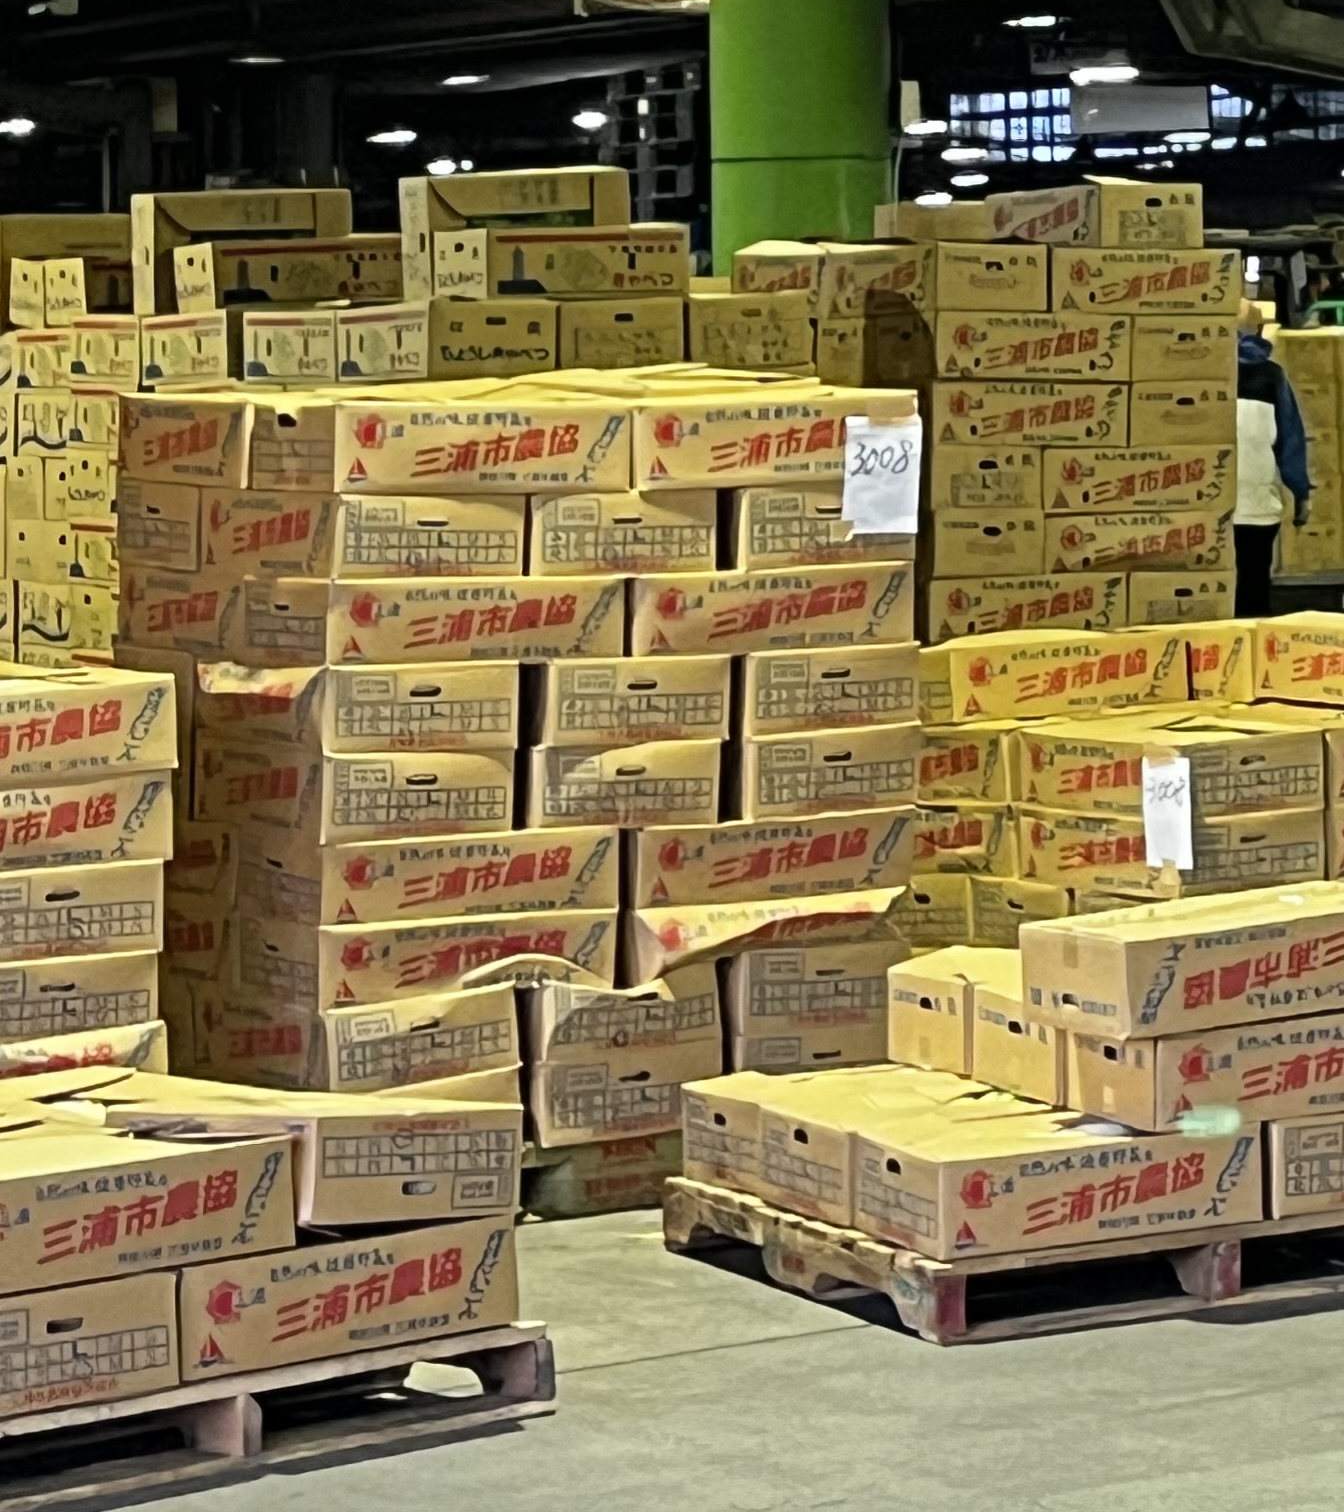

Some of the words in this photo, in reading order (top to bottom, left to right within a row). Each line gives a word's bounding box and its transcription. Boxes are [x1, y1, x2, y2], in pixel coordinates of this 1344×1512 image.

[708, 419, 846, 472] 三浦市農
[1021, 1152, 1206, 1235] 三浦市農協
